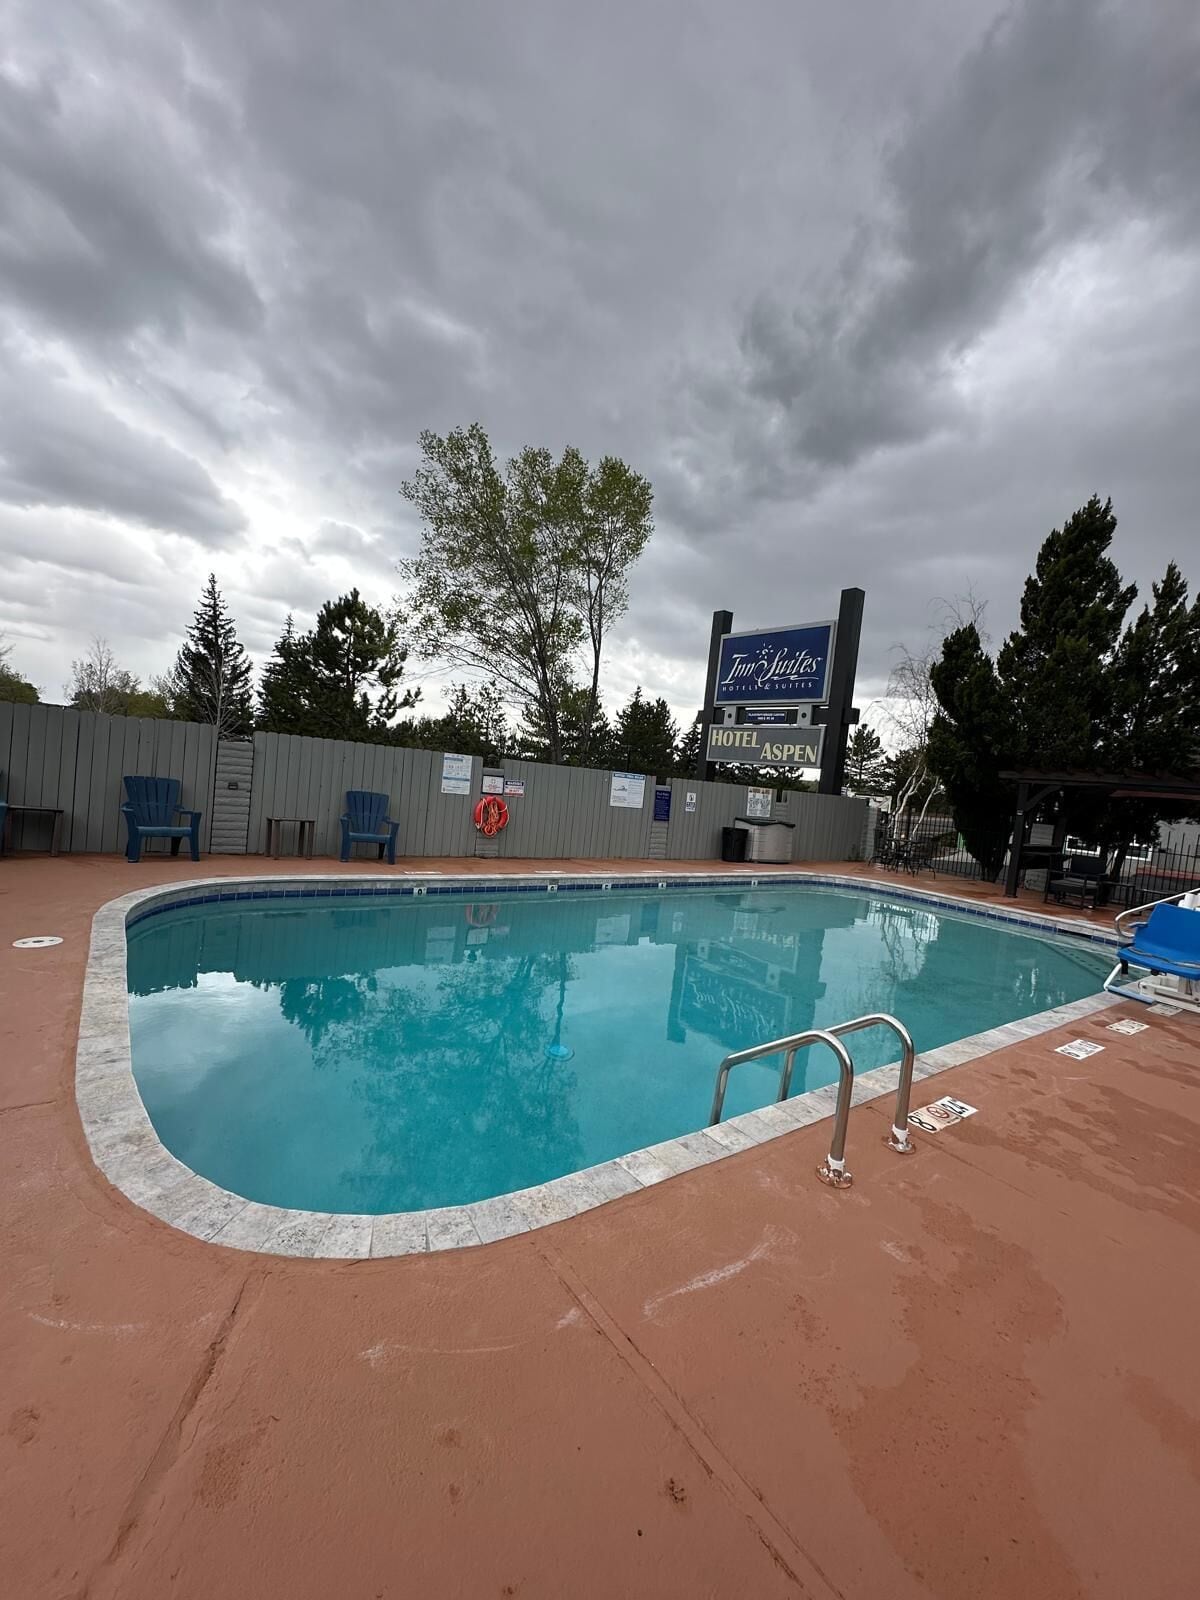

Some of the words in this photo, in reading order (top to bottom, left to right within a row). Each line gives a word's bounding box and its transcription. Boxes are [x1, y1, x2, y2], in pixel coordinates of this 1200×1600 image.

[775, 682, 813, 690] SUITES
[711, 729, 760, 748] HOTEL
[760, 742, 817, 763] ASPEN
